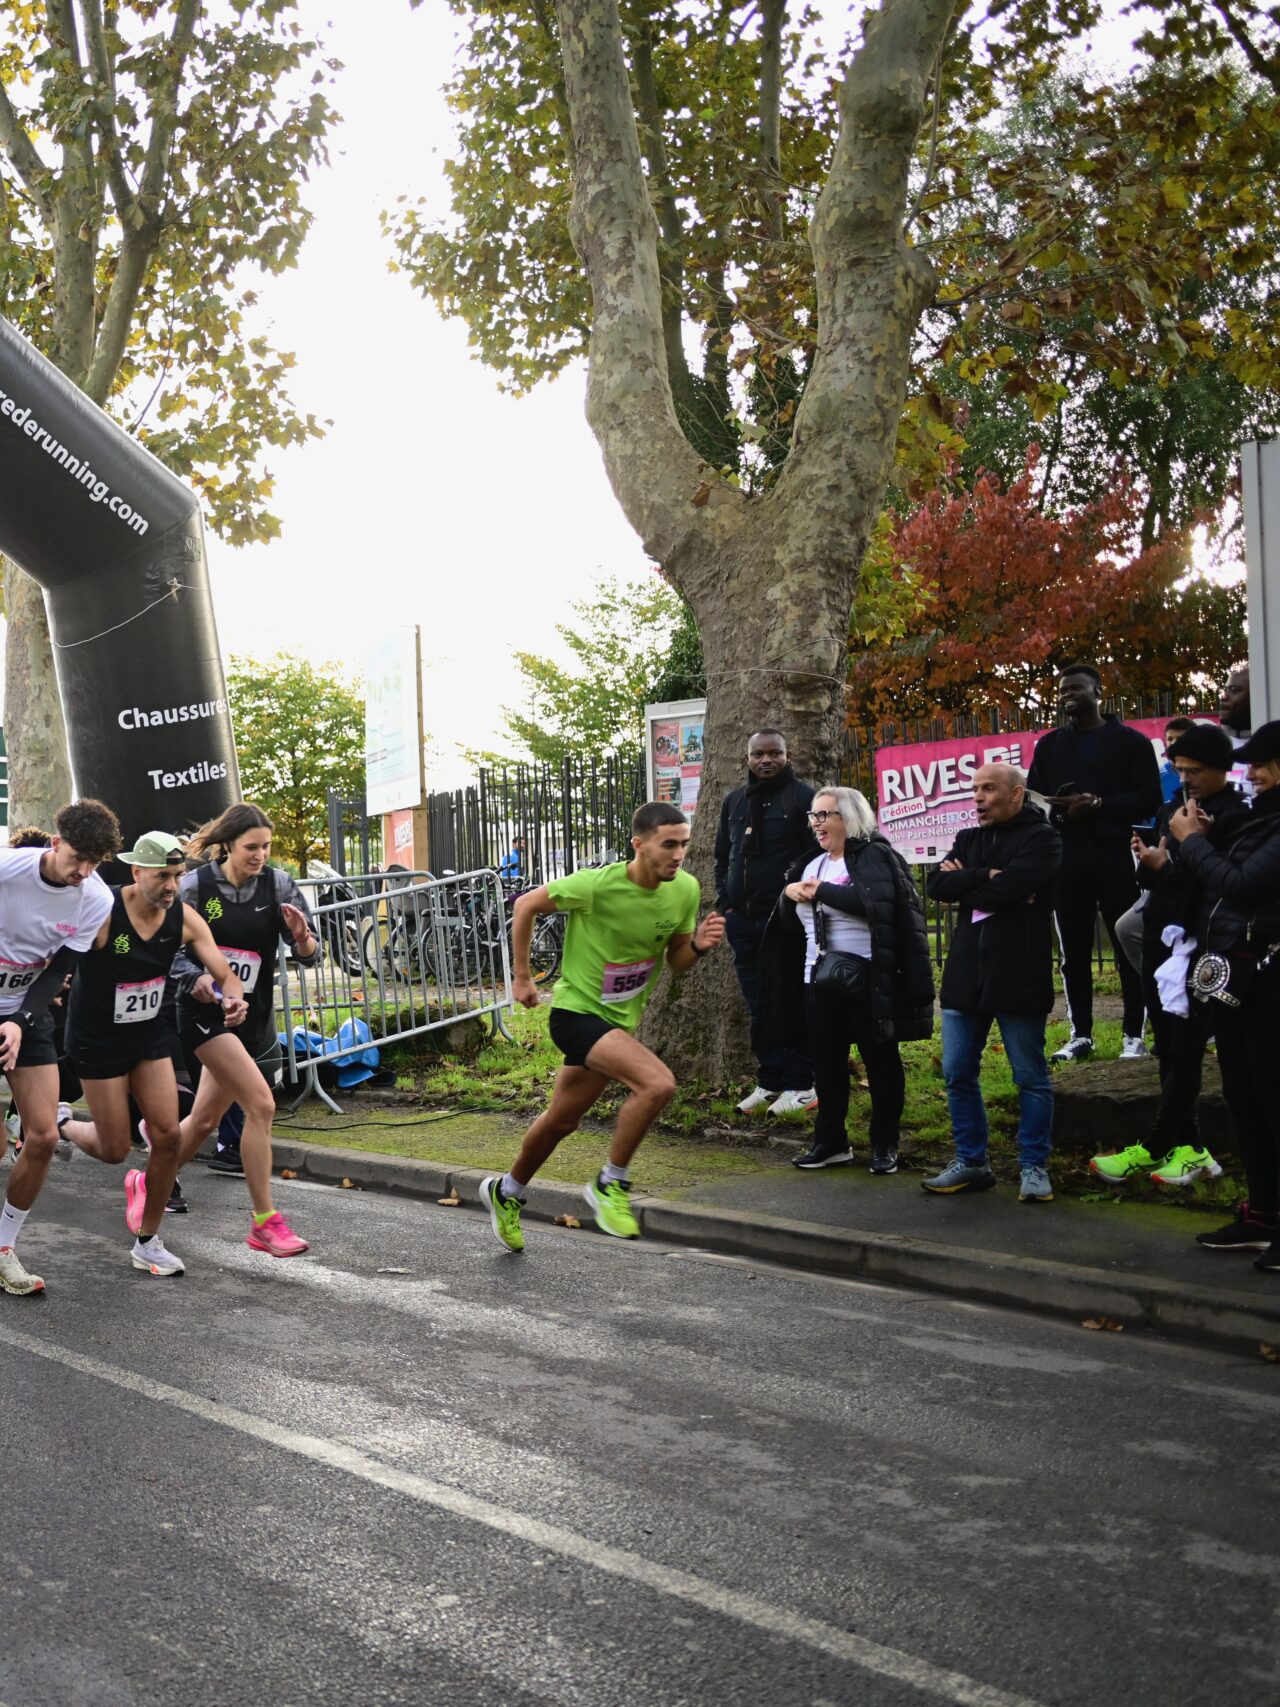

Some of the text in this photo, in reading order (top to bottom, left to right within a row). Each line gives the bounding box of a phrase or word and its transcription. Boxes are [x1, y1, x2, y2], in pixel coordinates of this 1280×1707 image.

[118, 698, 227, 730] Chaussures
[148, 761, 227, 790] Textiles
[890, 801, 923, 817] édition
[888, 813, 946, 832] DIMANCHE
[908, 830, 926, 840] Parc
[125, 990, 159, 1012] 210
